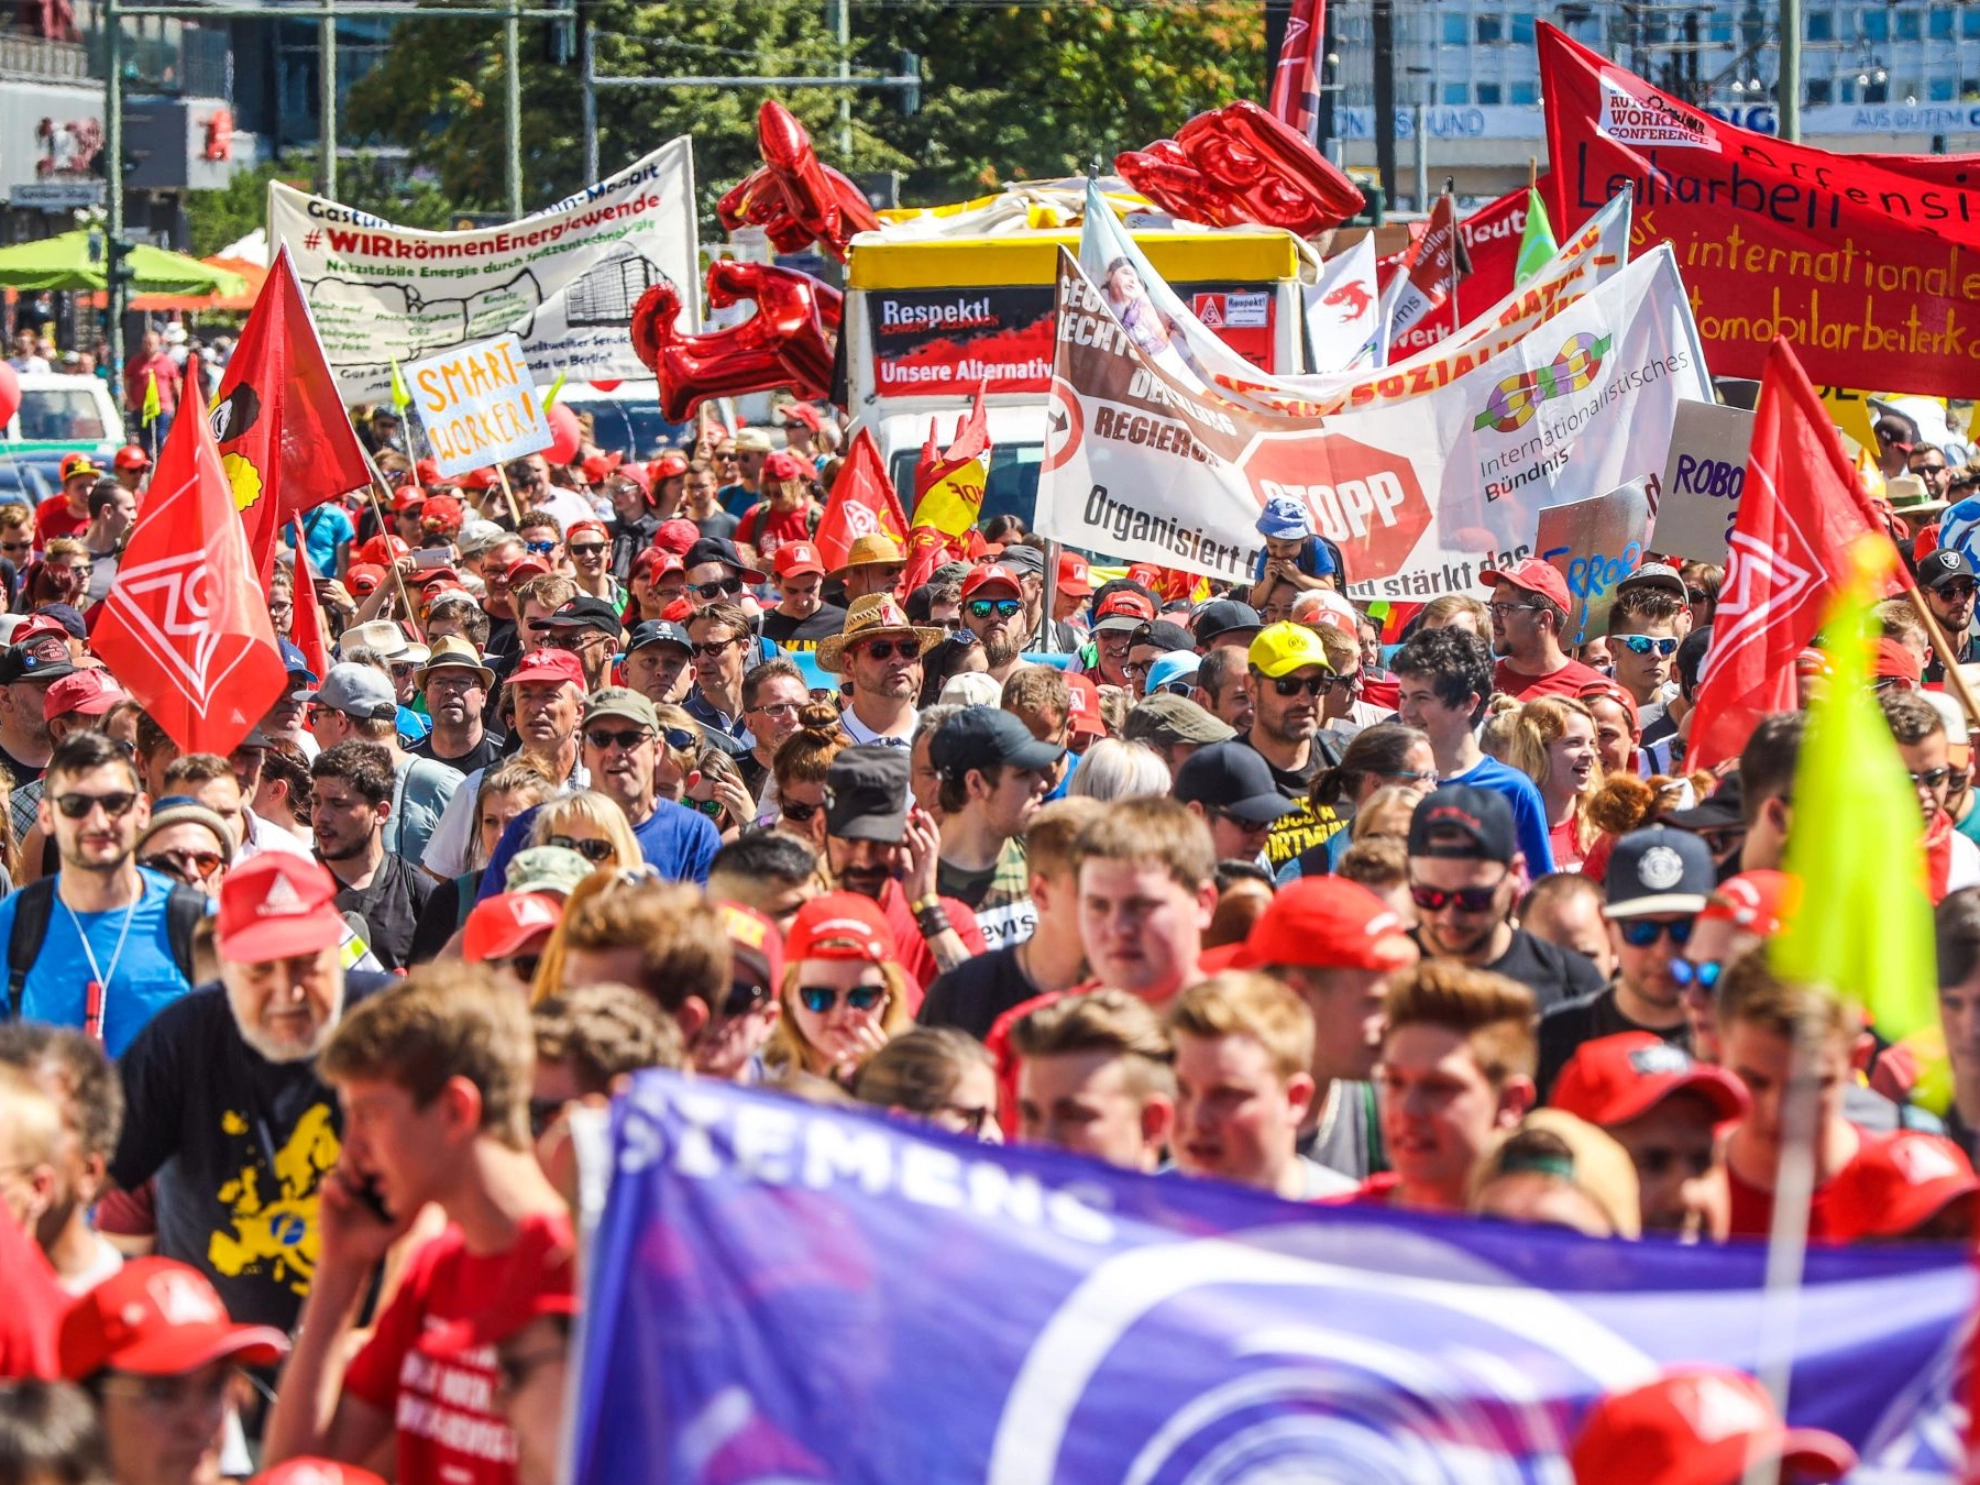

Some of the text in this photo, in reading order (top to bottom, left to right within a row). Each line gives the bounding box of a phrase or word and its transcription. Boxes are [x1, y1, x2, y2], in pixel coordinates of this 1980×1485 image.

[1607, 126, 1709, 145] CONFERENCE
[419, 265, 479, 279] Energie
[483, 255, 524, 275] durch
[883, 297, 990, 329] Respekt!
[417, 341, 526, 413] SMART-
[881, 361, 951, 383] Unsere
[429, 391, 539, 461] WORKER!
[1480, 350, 1688, 477] Internationalistisches
[1485, 449, 1570, 503] Bündnis
[1083, 484, 1241, 574] Organisiert
[1384, 562, 1472, 597] stärkt
